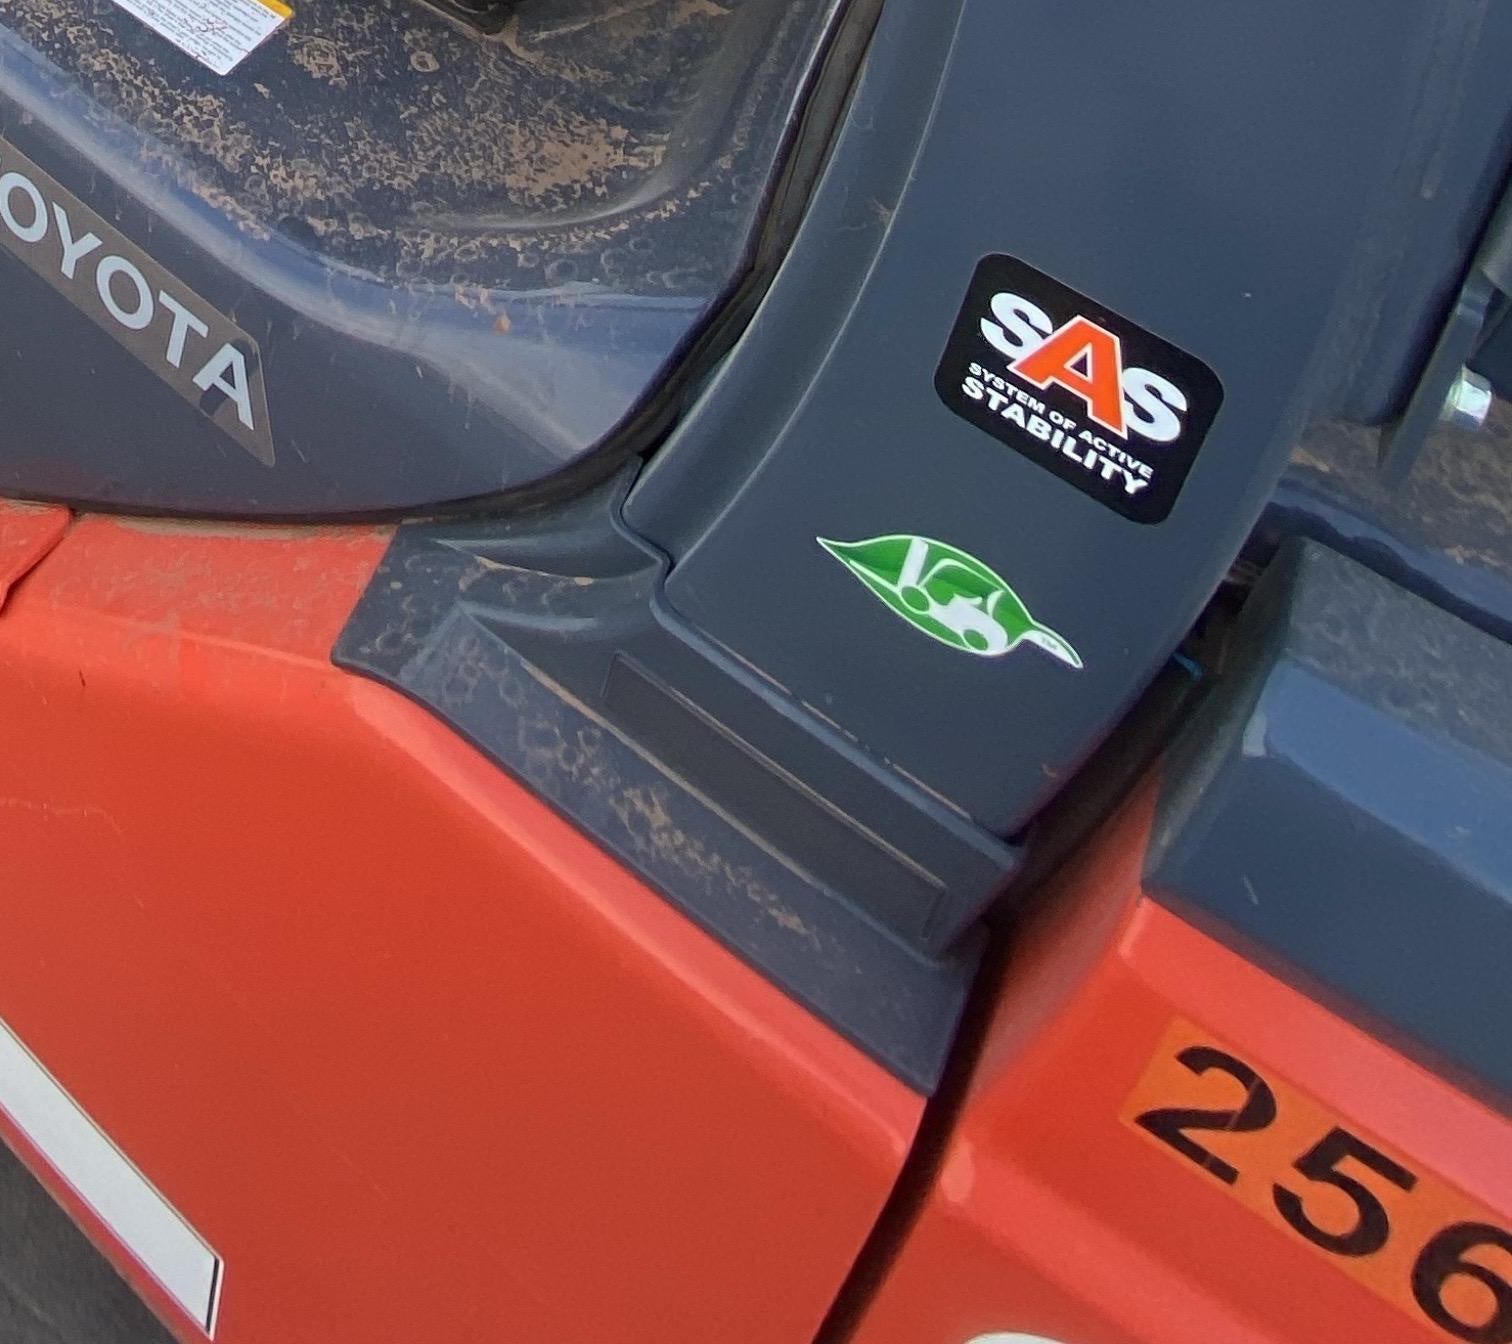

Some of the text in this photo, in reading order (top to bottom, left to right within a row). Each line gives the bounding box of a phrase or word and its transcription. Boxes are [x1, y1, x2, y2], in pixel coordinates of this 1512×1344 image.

[968, 362, 1155, 479] SYSTEM OF ACTIVE
[980, 291, 1189, 443] SAS
[961, 376, 1149, 497] STABILITY
